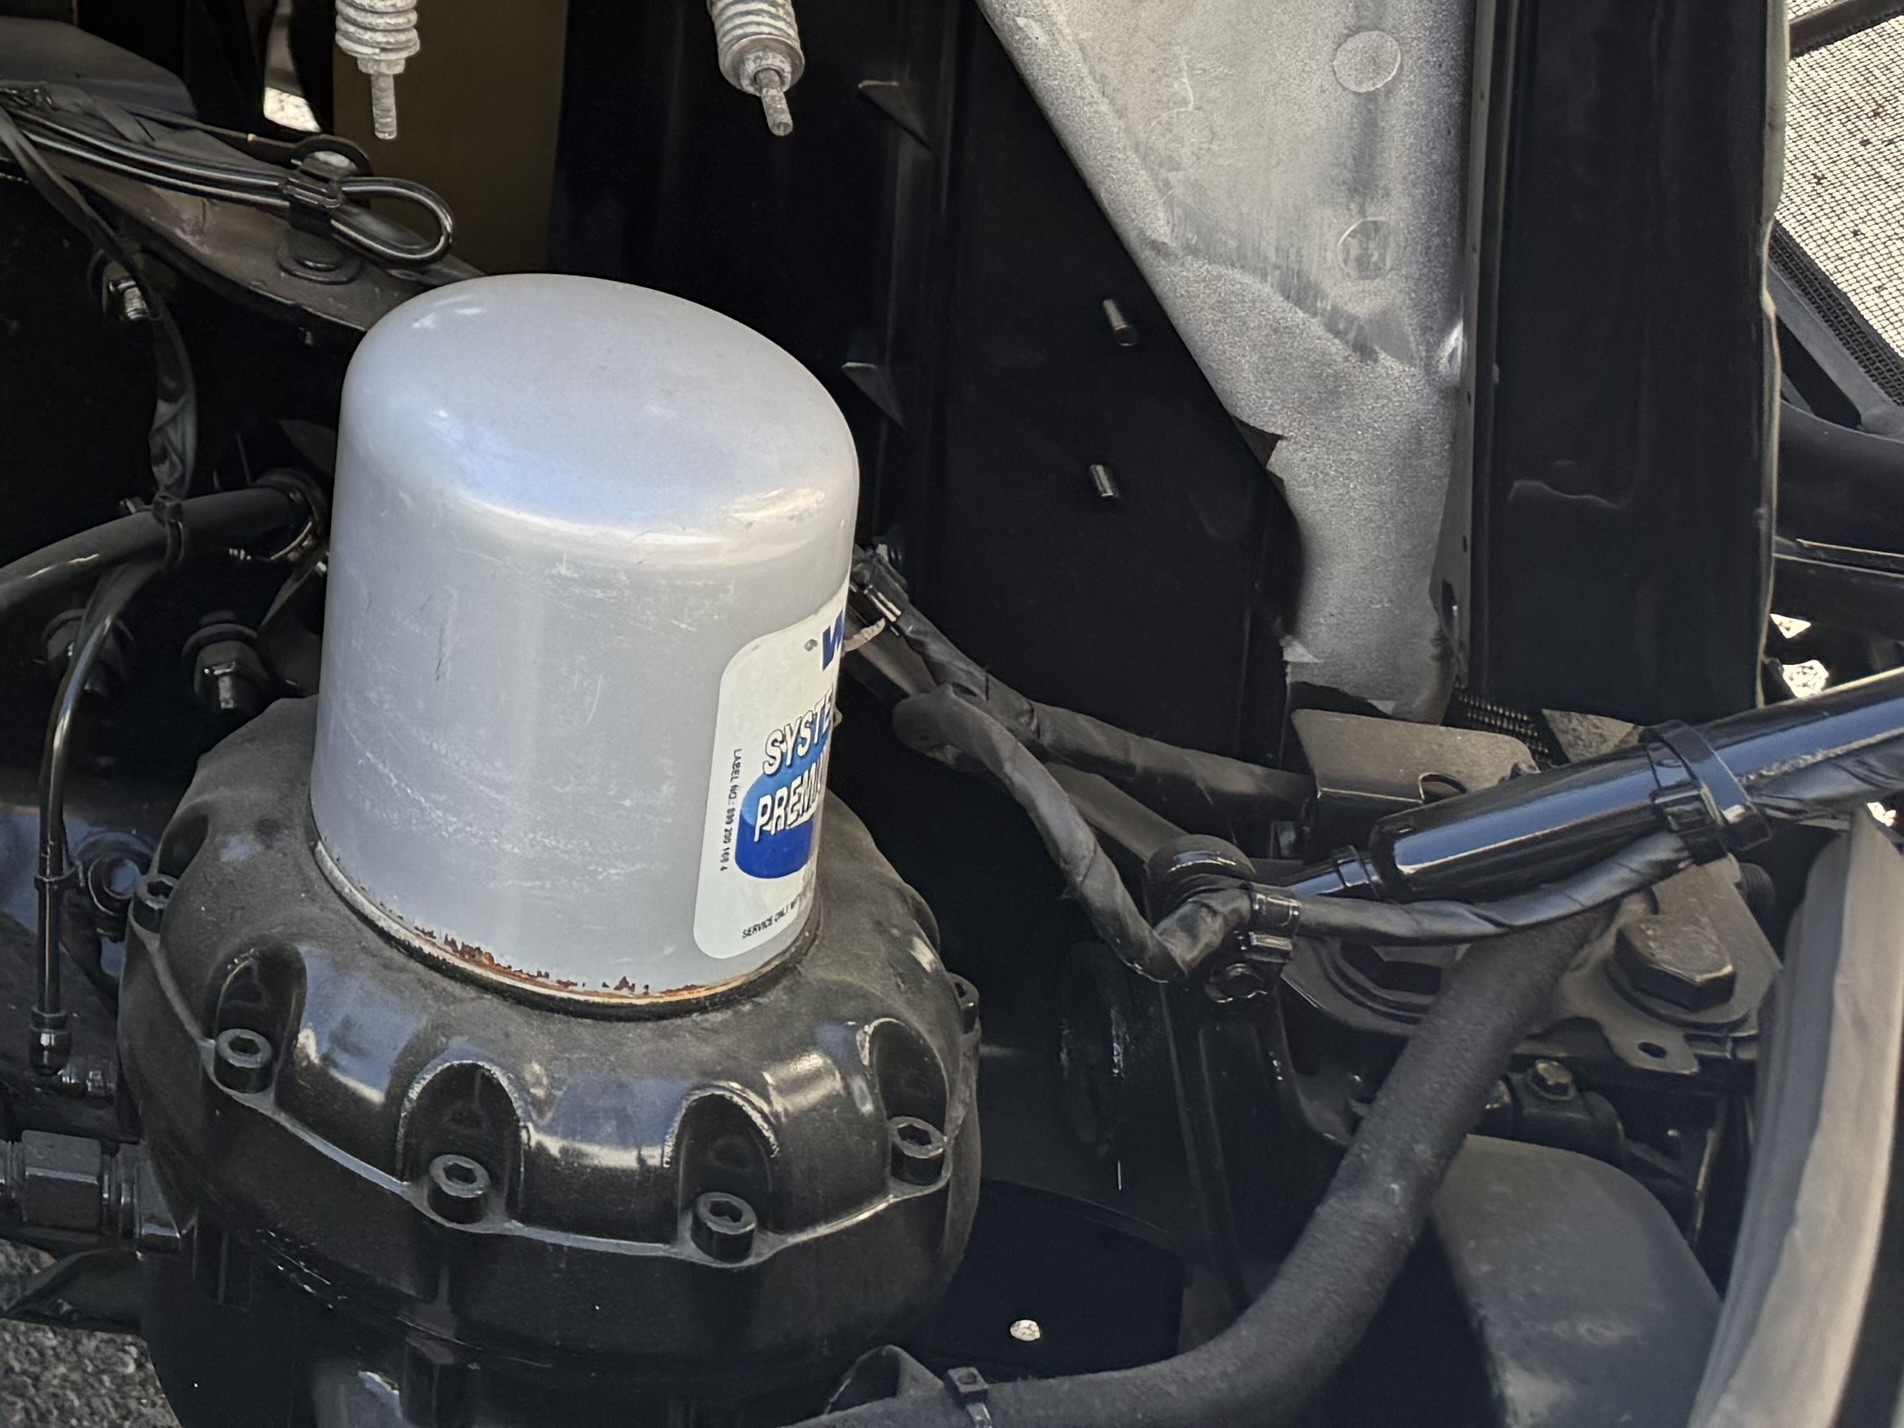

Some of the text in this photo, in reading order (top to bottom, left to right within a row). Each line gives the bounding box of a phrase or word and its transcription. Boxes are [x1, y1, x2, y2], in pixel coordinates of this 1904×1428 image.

[762, 688, 832, 776] SYSTE
[729, 748, 743, 784] LABEL
[742, 911, 774, 941] SERVICE
